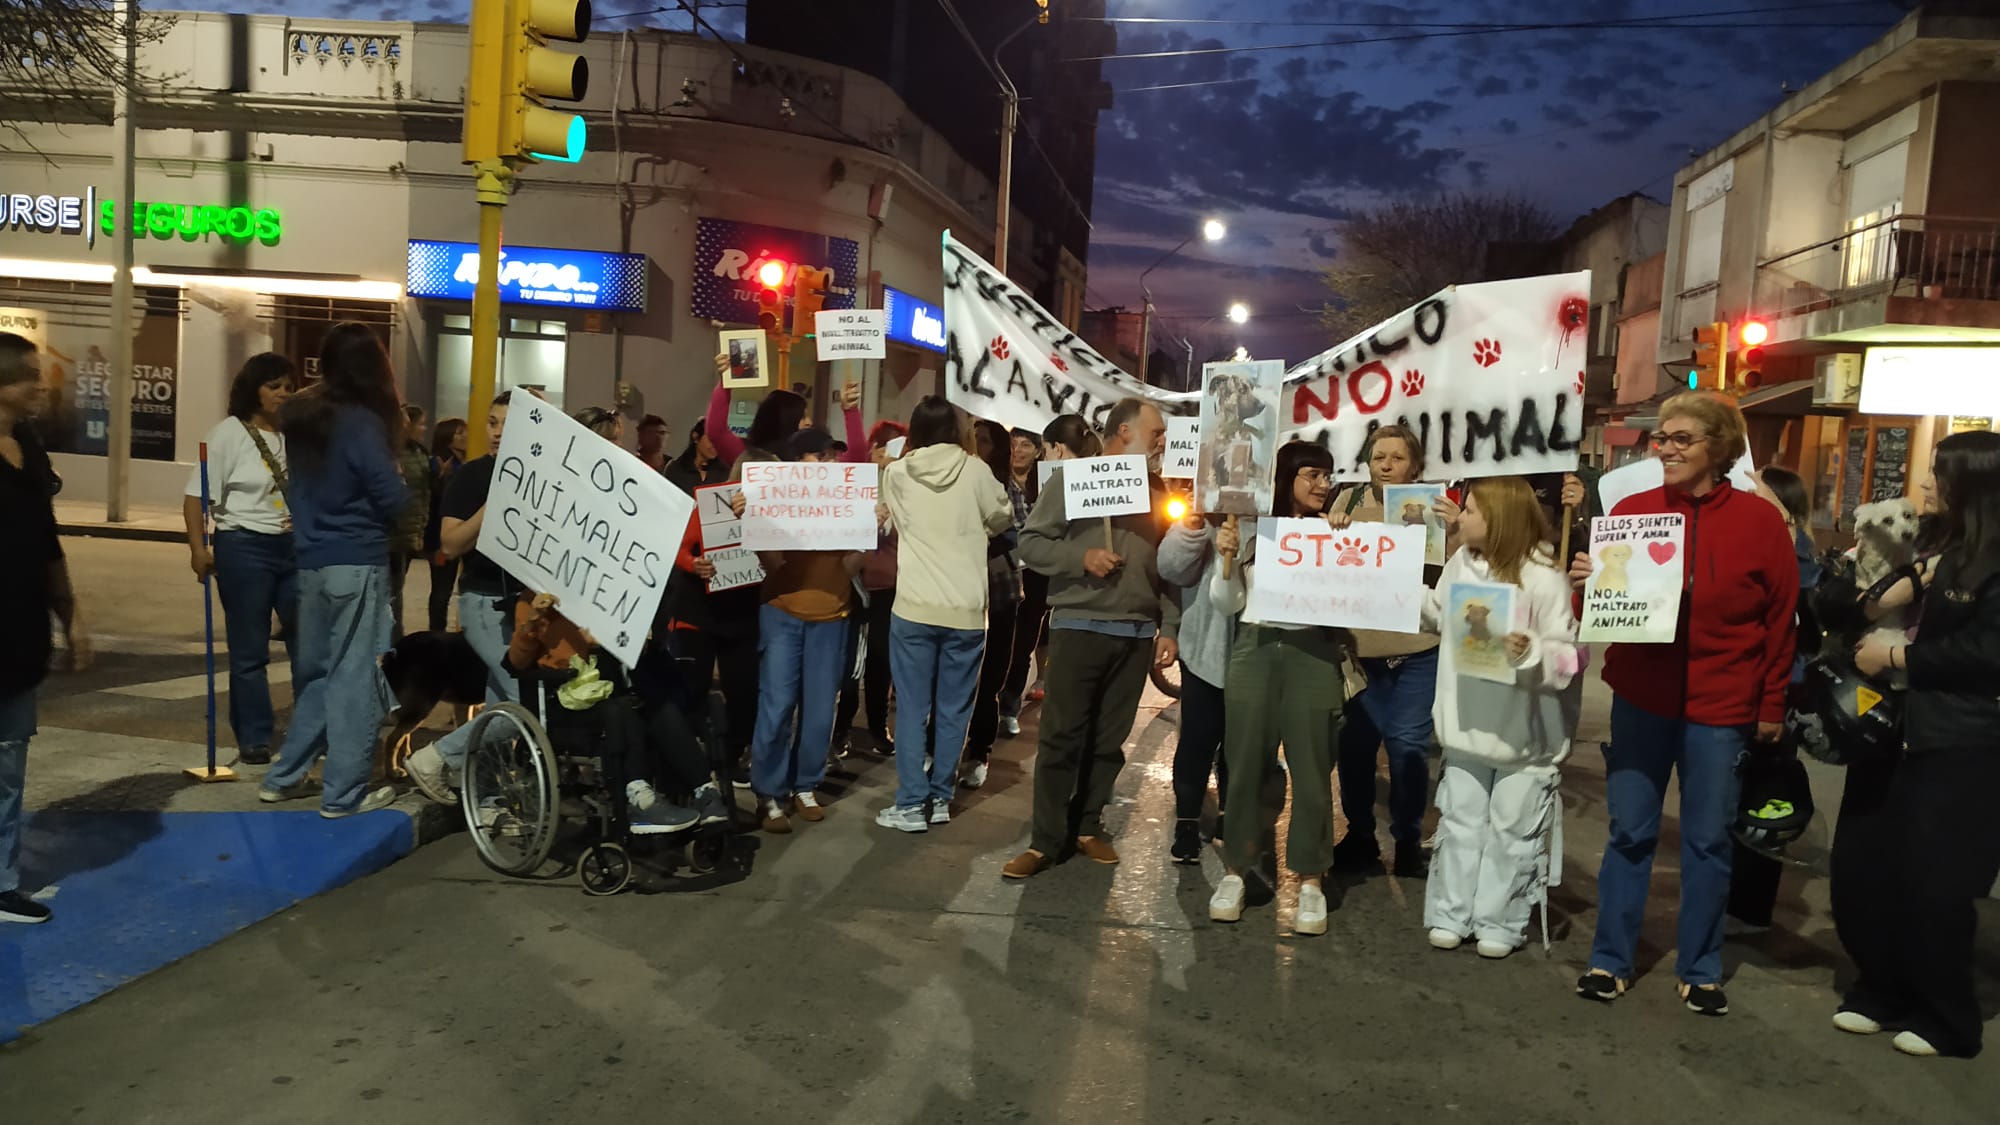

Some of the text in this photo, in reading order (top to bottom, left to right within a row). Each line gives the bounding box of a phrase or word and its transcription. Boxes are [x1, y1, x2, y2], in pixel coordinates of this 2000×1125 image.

[0, 193, 81, 229] RSE
[838, 315, 872, 324] NO AL
[133, 365, 173, 380] STAR
[75, 376, 172, 401] SERO
[1291, 359, 1393, 425] NO
[746, 465, 829, 483] ESTADO
[1091, 462, 1132, 473] NO AL
[561, 434, 639, 518] LOS
[1070, 477, 1143, 492] MALTRATO
[1082, 494, 1134, 508] ANIMAL
[1597, 516, 1683, 532] ELLOS SIENTEN
[1595, 532, 1627, 543] SUFREN
[1632, 531, 1639, 539] Y
[1614, 590, 1629, 599] AL
[1590, 602, 1648, 612] MALTRATO
